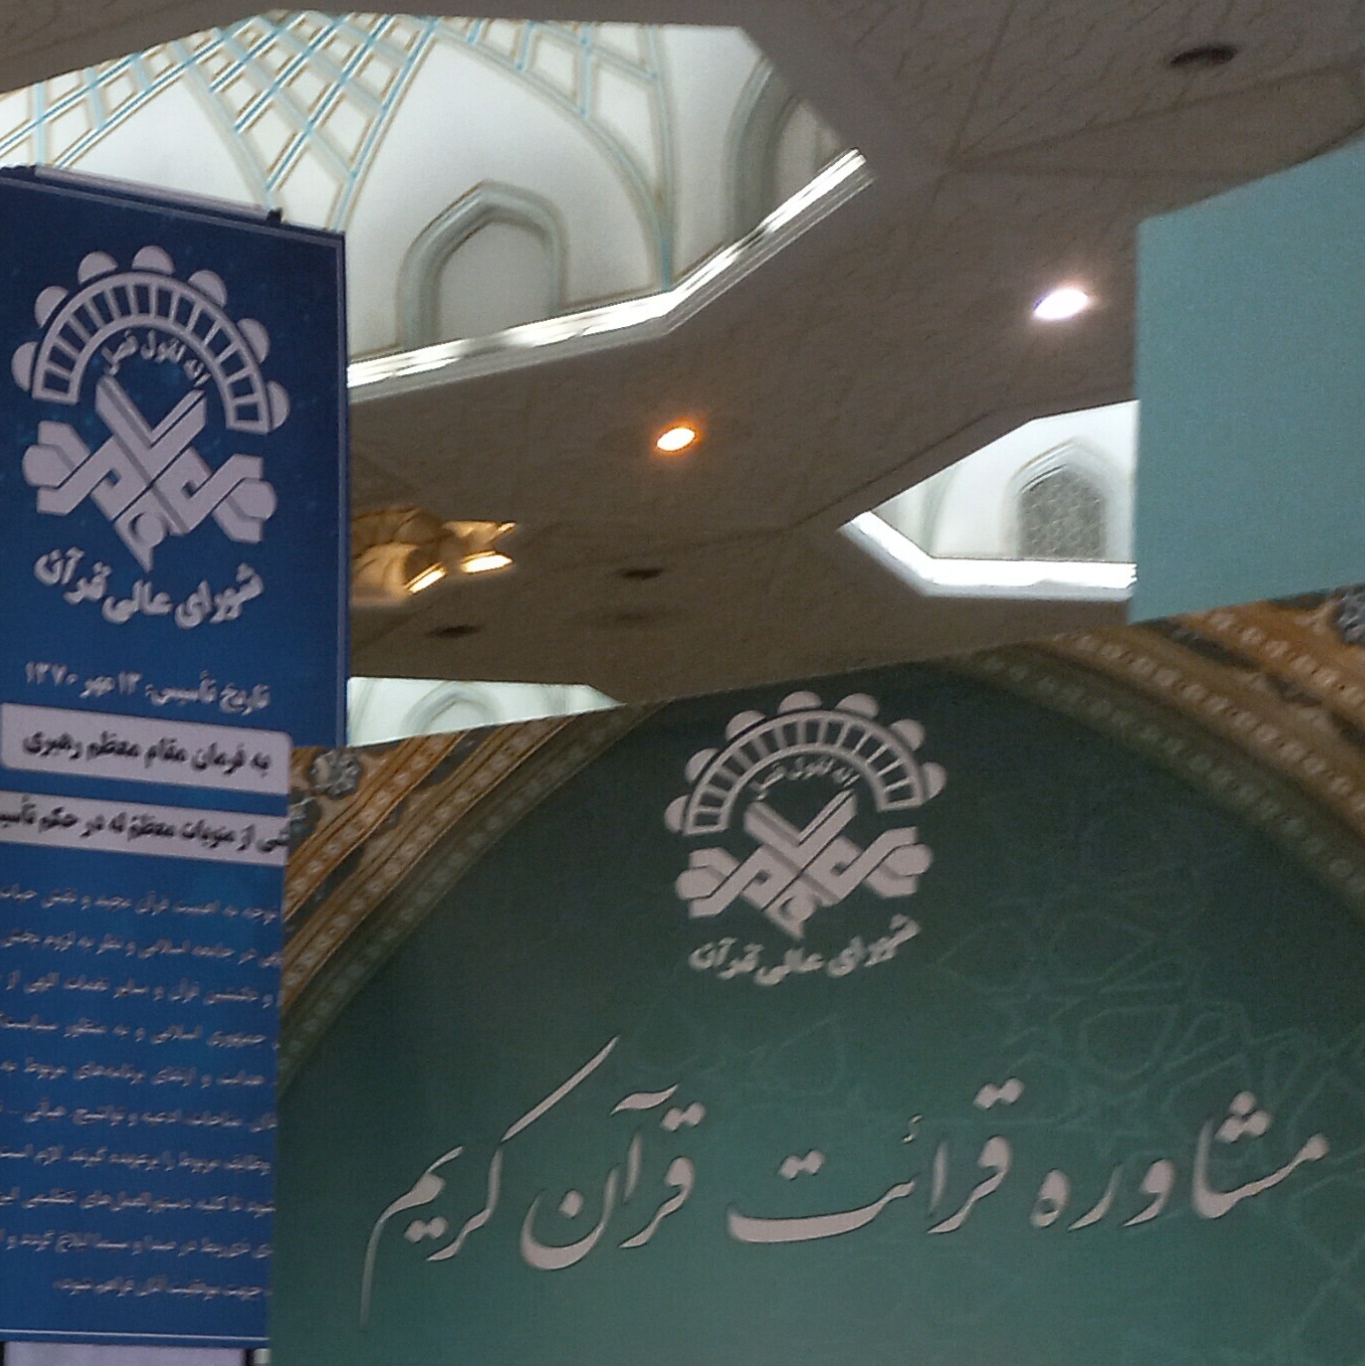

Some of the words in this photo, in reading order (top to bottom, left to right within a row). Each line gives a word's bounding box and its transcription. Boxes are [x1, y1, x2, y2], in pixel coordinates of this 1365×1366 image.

[34, 547, 112, 604] قرآن
[175, 563, 264, 629] شورای
[101, 580, 173, 624] عالی
[219, 684, 270, 715] تاریخ
[22, 731, 84, 761] رهبری
[86, 731, 141, 761] معظم
[144, 737, 188, 768] مقام
[191, 742, 245, 775] فرمان
[250, 750, 271, 777] به
[80, 813, 105, 840] در
[689, 937, 764, 980] قرآن
[827, 913, 921, 978] شورای
[753, 948, 824, 987] عالی
[521, 1083, 708, 1270] قرآن
[726, 1075, 1026, 1245] قرائت
[1029, 1088, 1332, 1229] مشاوره
[360, 1035, 619, 1332] کریم
